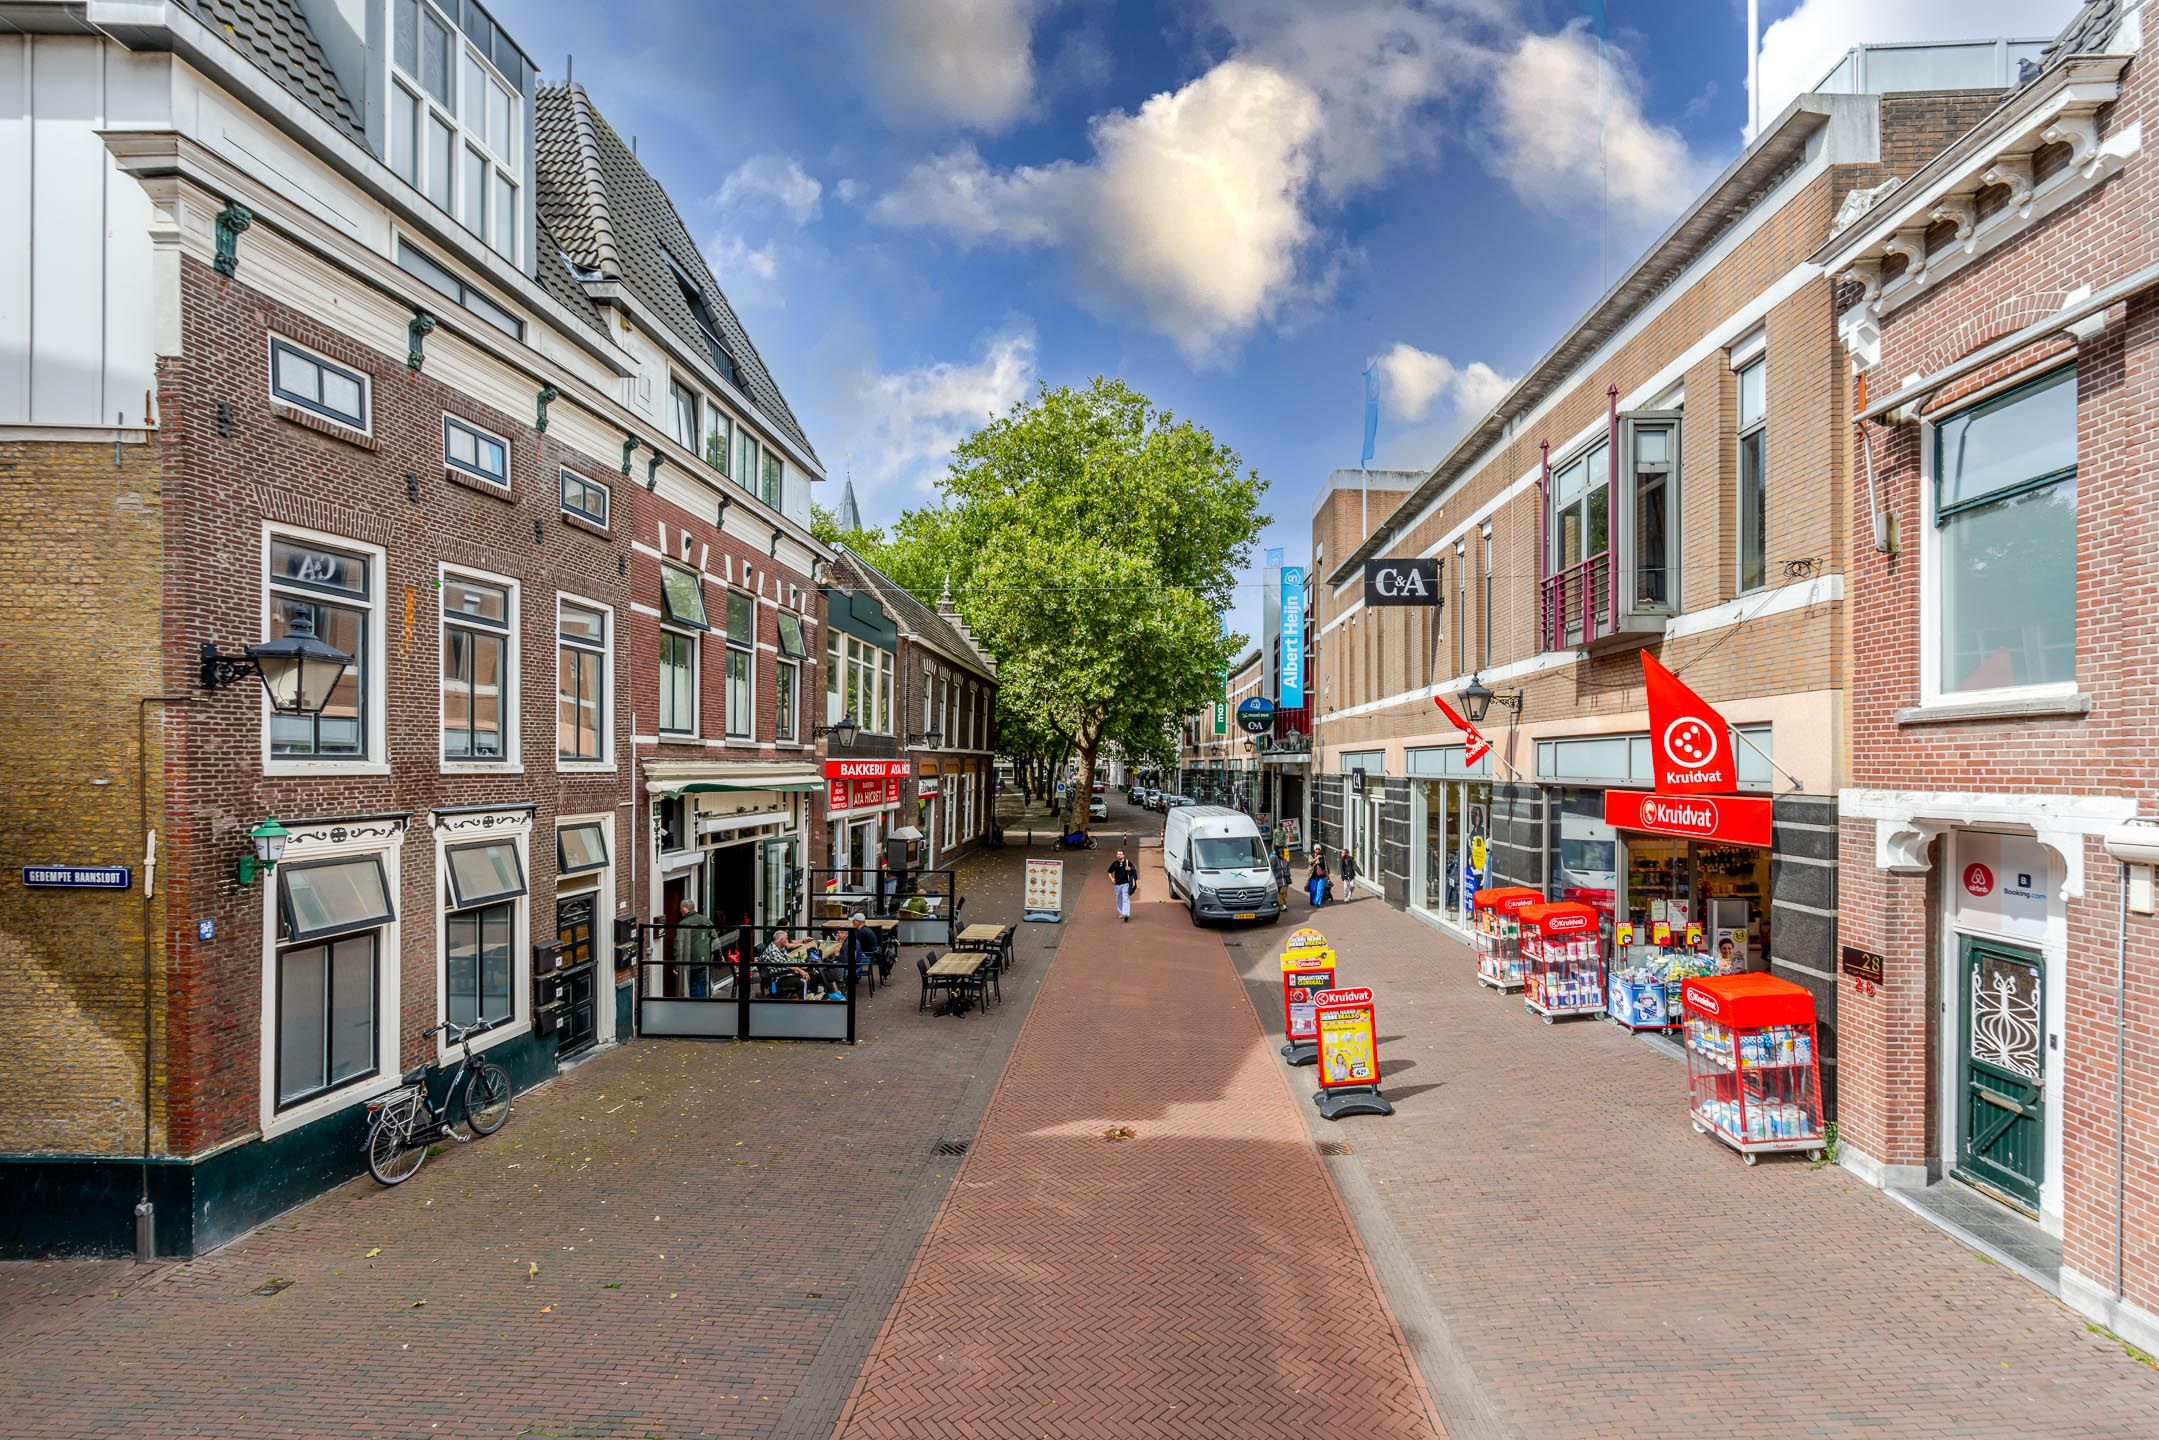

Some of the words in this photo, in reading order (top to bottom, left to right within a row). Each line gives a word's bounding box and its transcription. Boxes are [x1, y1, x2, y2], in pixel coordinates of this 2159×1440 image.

[1375, 568, 1429, 596] C&A
[1283, 595, 1301, 635] Heijn
[1283, 637, 1298, 689] Albert
[1247, 721, 1263, 730] C&A
[1666, 770, 1722, 784] Kruidvat
[854, 793, 864, 806] AYA
[864, 790, 882, 804] HICRET
[1657, 804, 1712, 828] Kruidvat
[29, 871, 72, 882] GEDEMPTE
[74, 872, 120, 883] BAANSLOOT
[1968, 885, 1988, 893] airbnb
[2003, 888, 2046, 899] Booking.com
[1862, 953, 1880, 972] 28
[1855, 977, 1874, 995] 28
[1328, 991, 1369, 1002] Kruidvat
[1694, 995, 1717, 1010] Kruidvat
